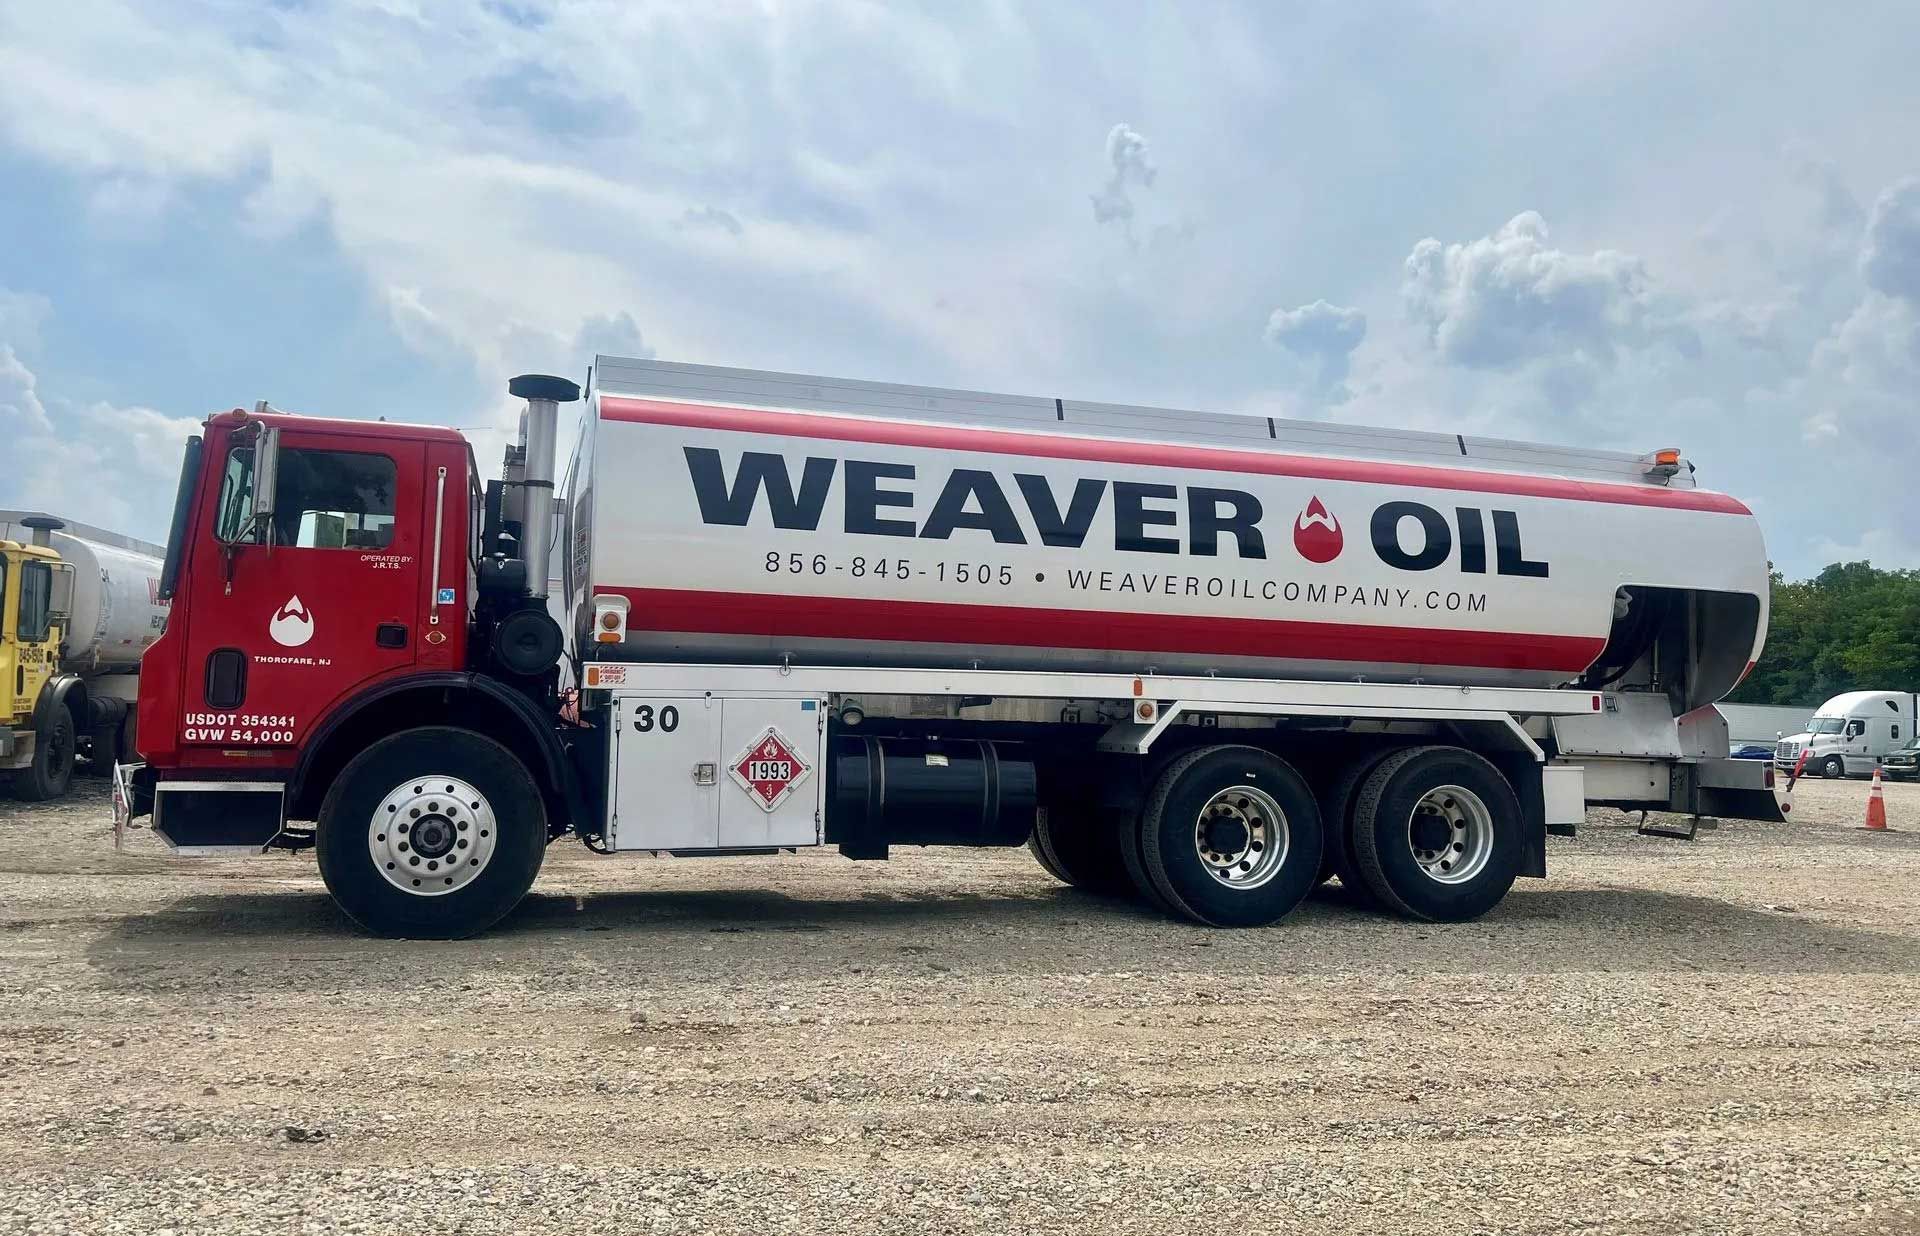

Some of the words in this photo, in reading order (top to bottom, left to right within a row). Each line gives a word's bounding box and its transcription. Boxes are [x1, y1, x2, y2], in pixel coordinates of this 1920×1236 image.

[682, 446, 1267, 560] WEAVER
[1370, 501, 1549, 578] OIL
[360, 554, 400, 563] OPERATED
[765, 552, 1013, 586] 856-845-1505
[1067, 569, 1487, 613] WEAVEROILCOMPANY.COM
[254, 655, 316, 666] THOROFARE,
[318, 658, 331, 666] NJ
[185, 713, 237, 726] USDOT
[241, 715, 296, 727] 354341
[633, 704, 680, 733] 30
[184, 728, 226, 741] GVW
[230, 729, 294, 744] 54,000
[750, 761, 790, 780] 1993
[766, 784, 773, 797] 3
